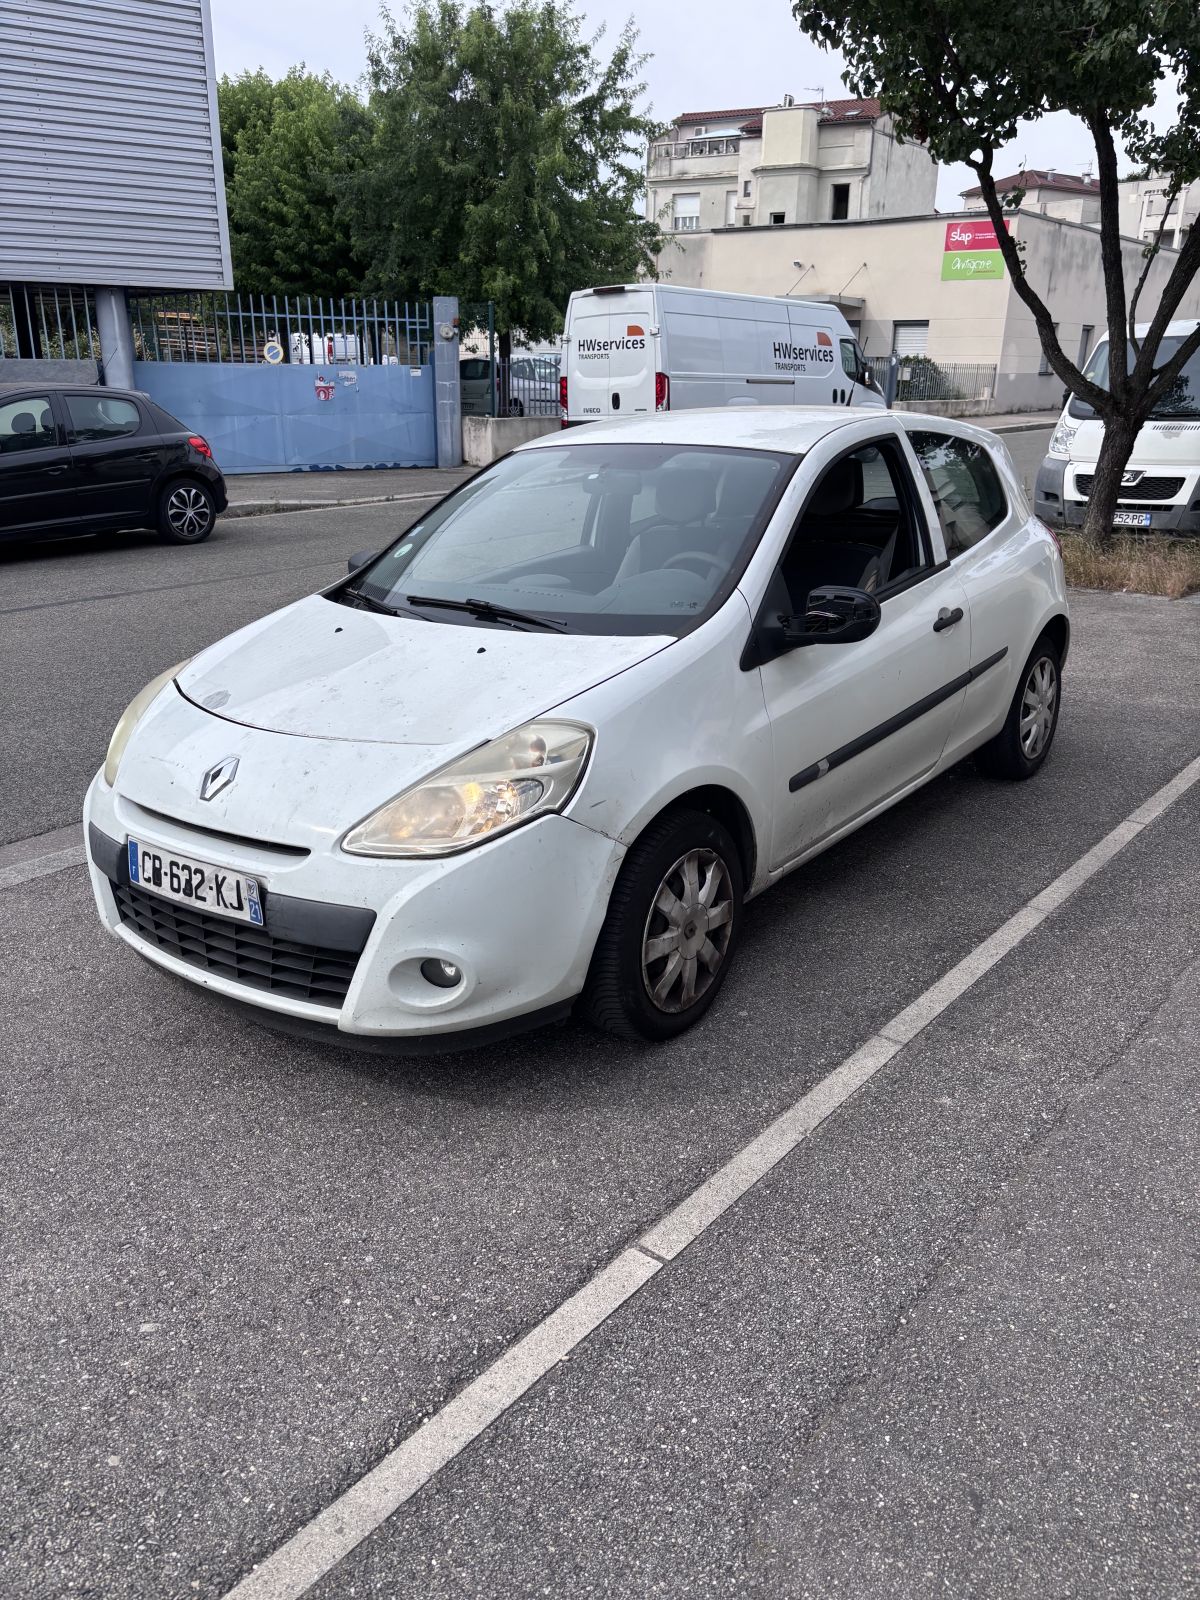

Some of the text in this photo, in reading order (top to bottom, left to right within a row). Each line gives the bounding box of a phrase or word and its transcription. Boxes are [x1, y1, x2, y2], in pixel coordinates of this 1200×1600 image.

[578, 336, 645, 352] HWservices
[773, 341, 834, 362] HWservices
[578, 353, 610, 361] TRANSPORTS
[774, 362, 807, 372] TRANSPORTS
[249, 901, 261, 920] 21
